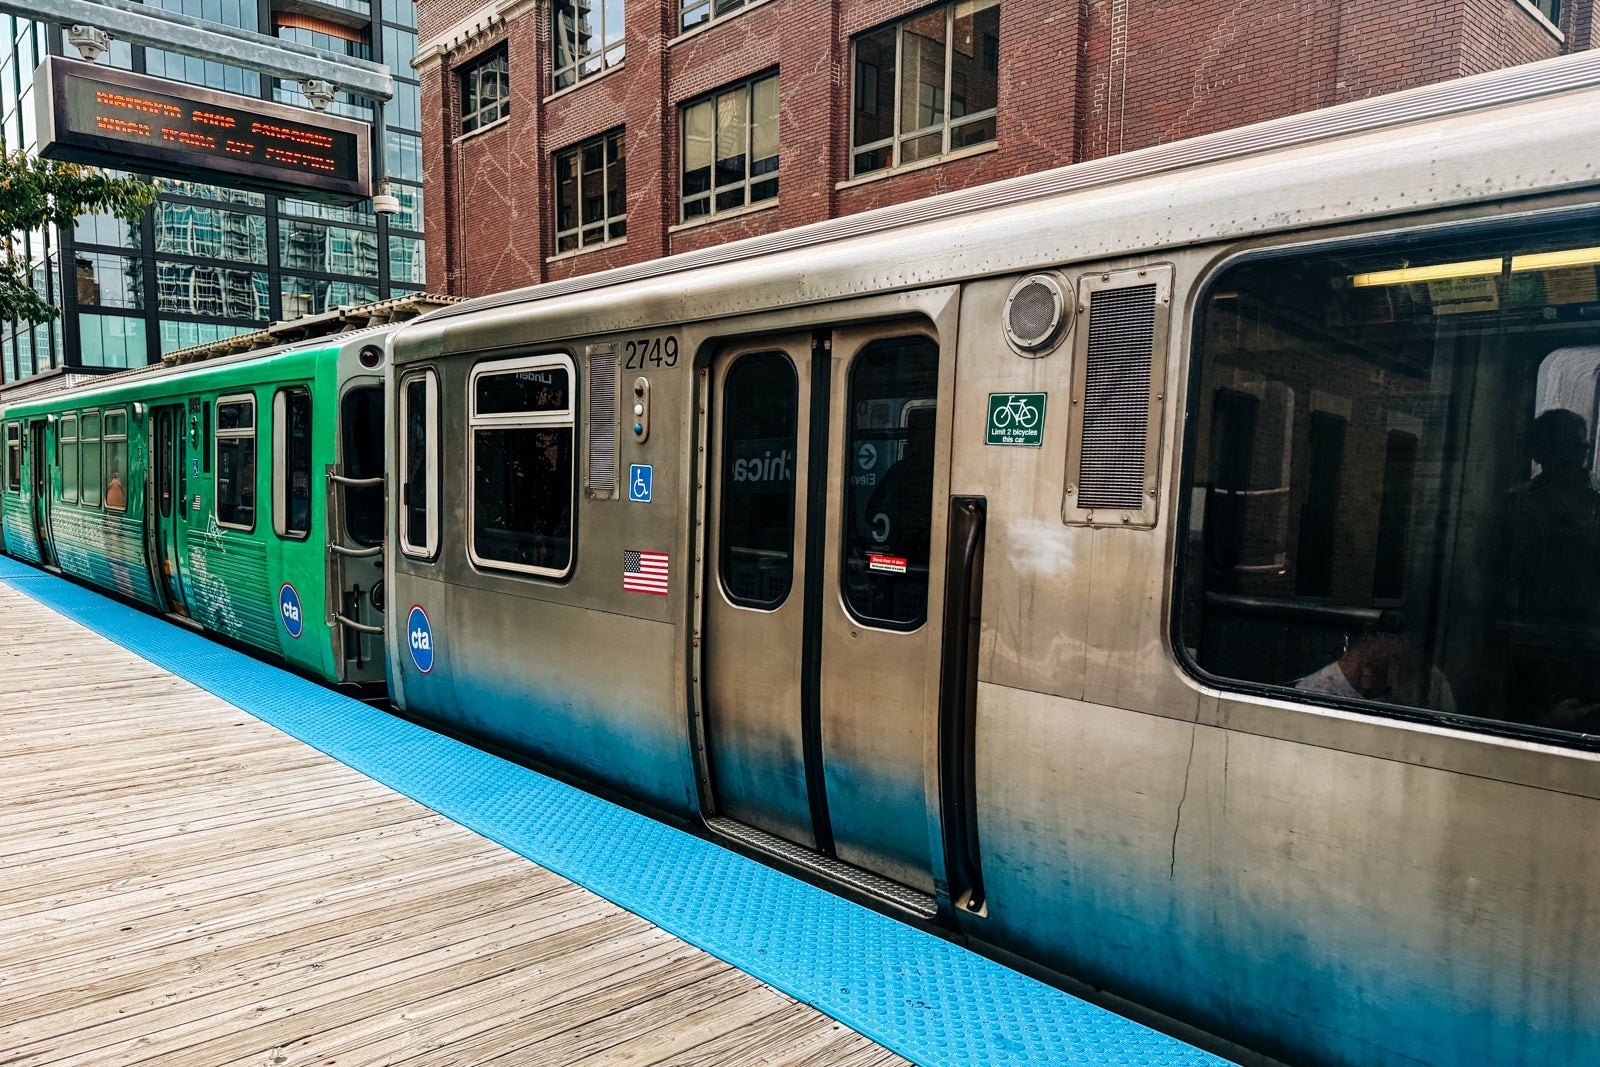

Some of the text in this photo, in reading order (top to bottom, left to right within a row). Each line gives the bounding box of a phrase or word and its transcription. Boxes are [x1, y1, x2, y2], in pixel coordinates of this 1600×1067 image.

[626, 335, 679, 370] 2749
[1013, 428, 1037, 437] bicycles
[283, 601, 299, 622] cta
[411, 627, 430, 650] cta
